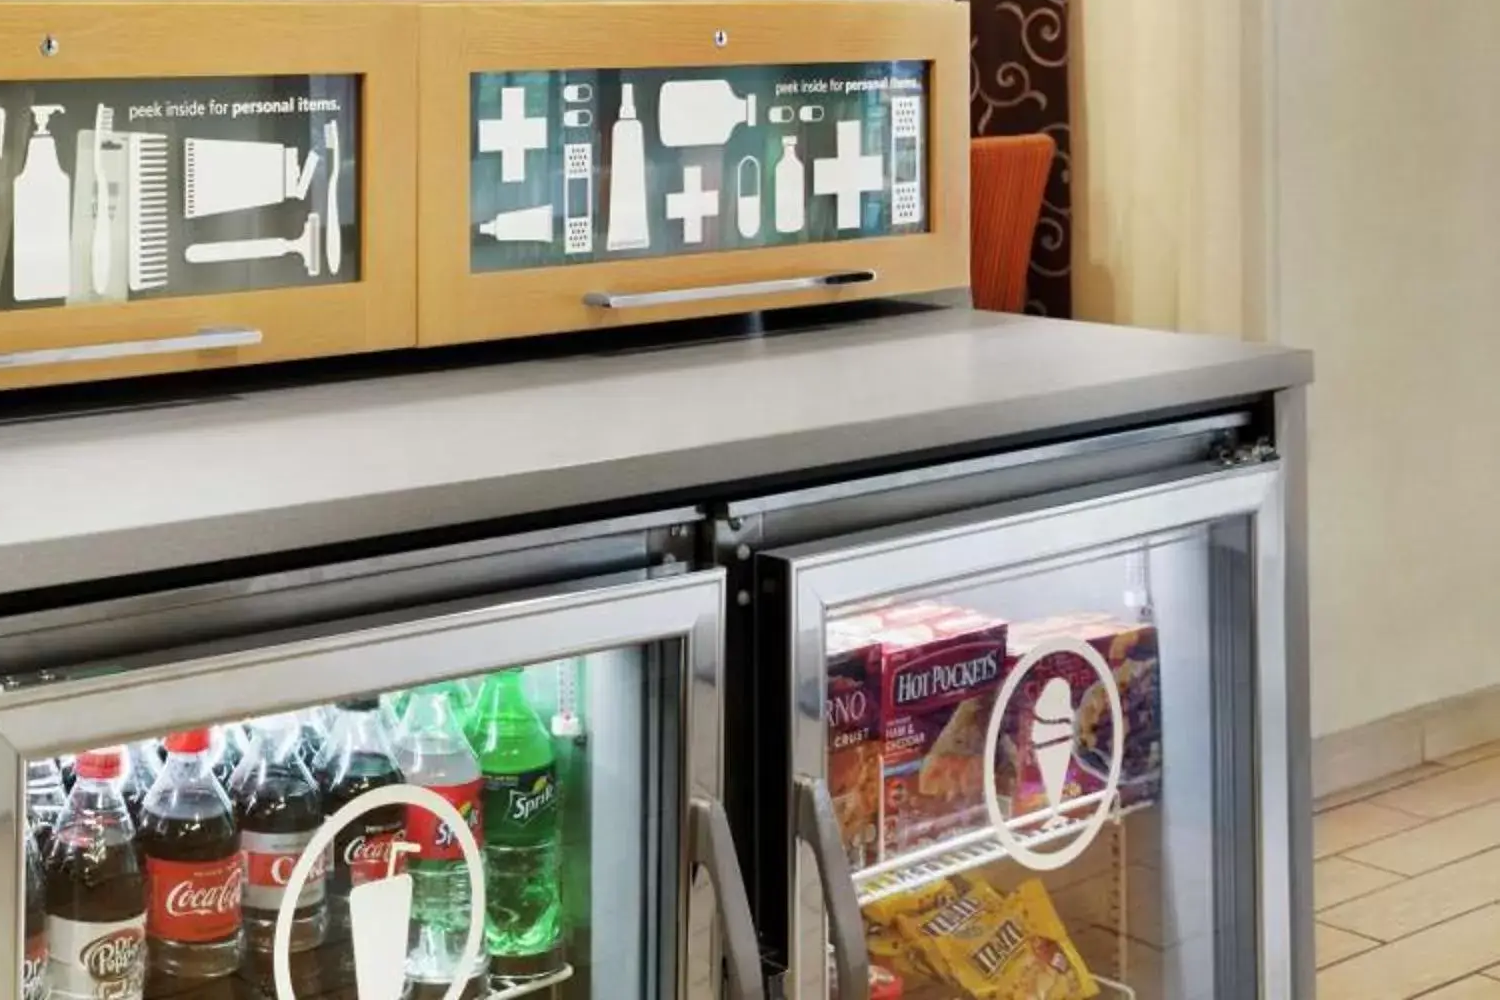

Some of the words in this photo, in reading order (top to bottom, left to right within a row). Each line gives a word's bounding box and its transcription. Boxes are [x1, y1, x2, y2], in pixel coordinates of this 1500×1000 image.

[775, 80, 799, 97] peek
[801, 79, 829, 93] inside
[830, 78, 844, 92] for
[129, 101, 162, 122] peek
[165, 100, 205, 117] inside
[209, 98, 229, 116] for
[232, 96, 294, 118] personal
[297, 96, 341, 112] items.
[897, 671, 931, 704] HOT
[931, 651, 998, 696] POCKETS
[833, 727, 871, 749] CRUST
